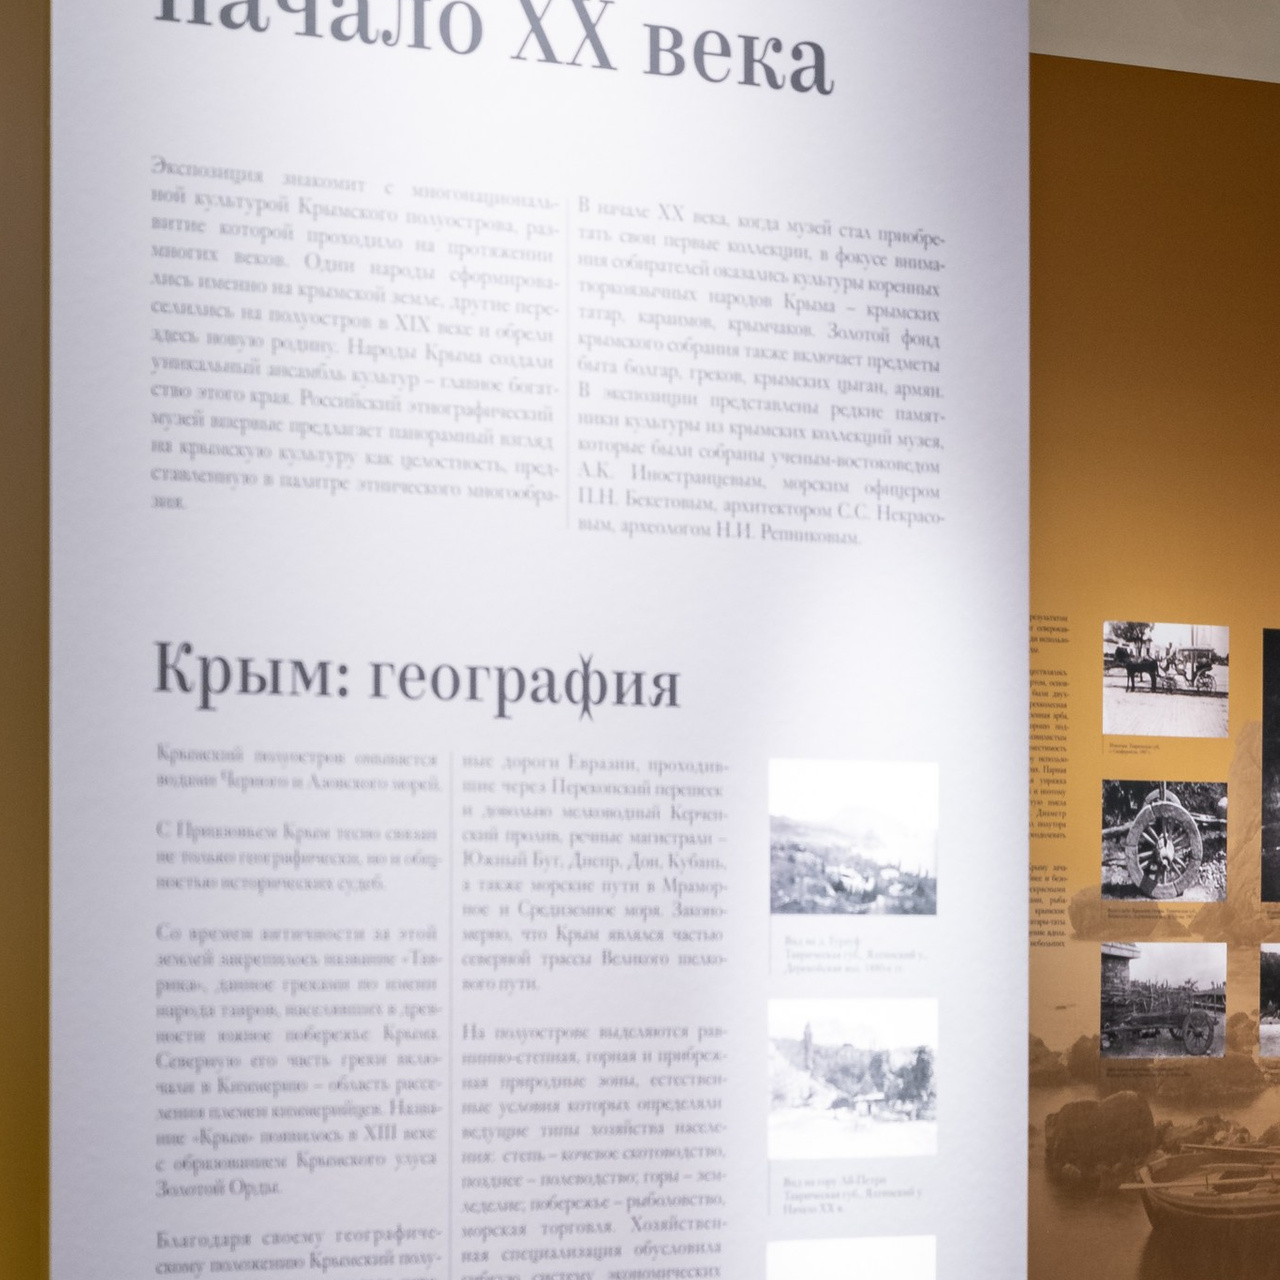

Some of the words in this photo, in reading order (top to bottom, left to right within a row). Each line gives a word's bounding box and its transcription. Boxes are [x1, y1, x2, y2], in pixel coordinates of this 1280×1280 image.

[643, 23, 834, 95] века
[153, 640, 349, 710] Крым:
[369, 654, 680, 721] география
